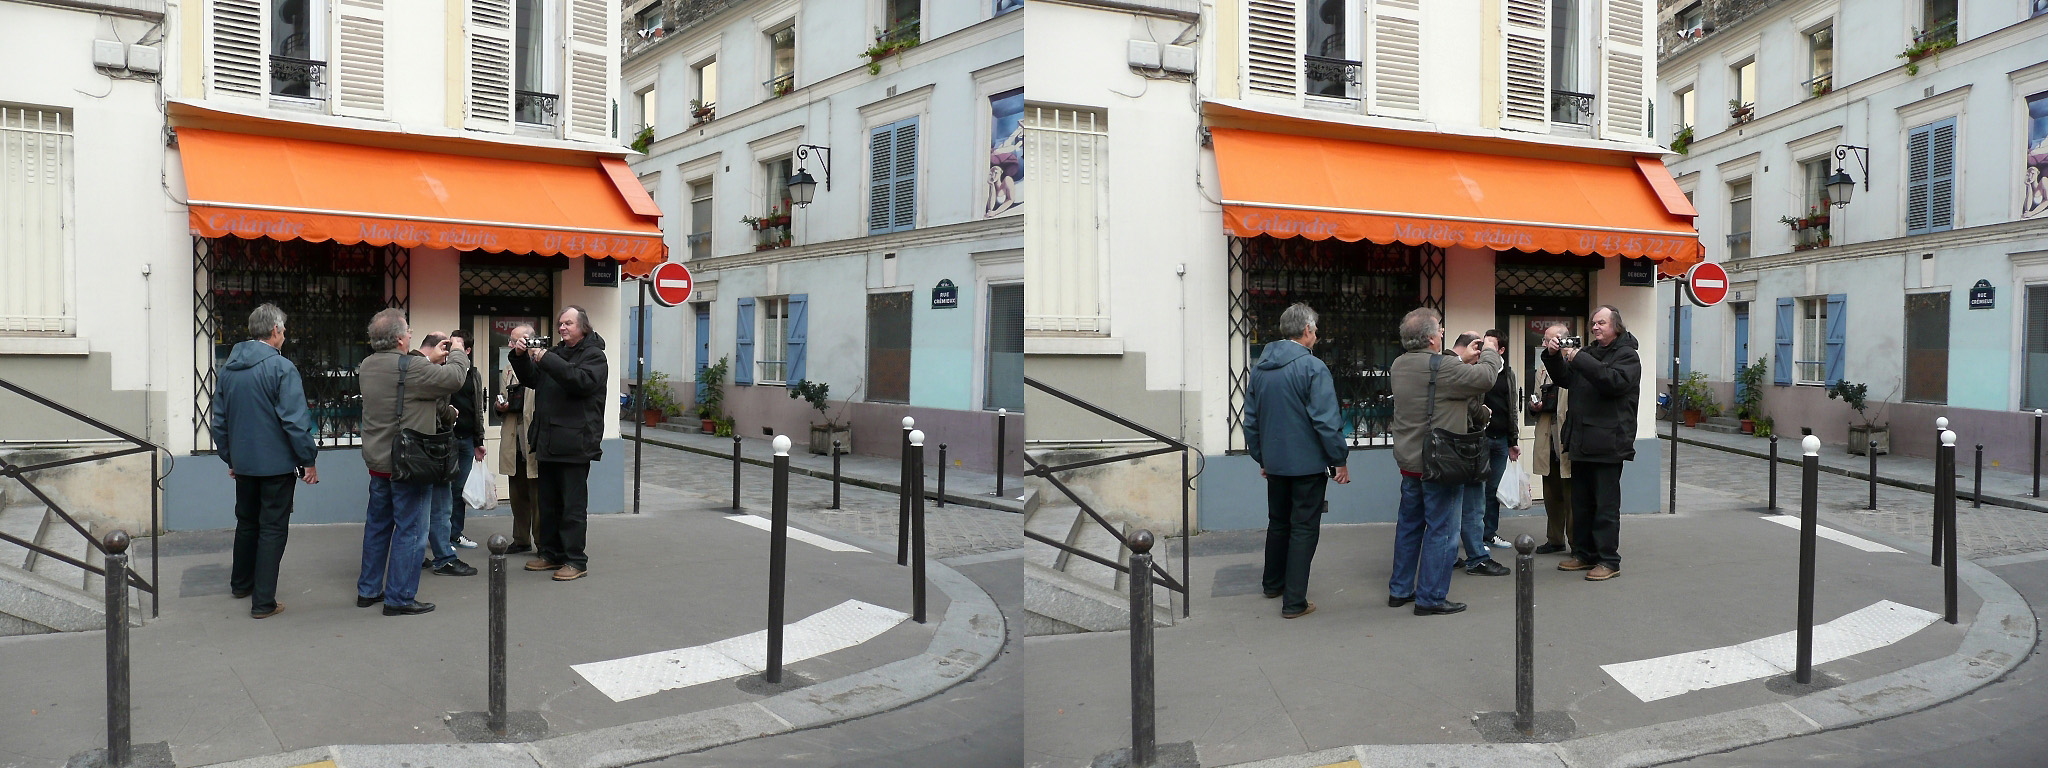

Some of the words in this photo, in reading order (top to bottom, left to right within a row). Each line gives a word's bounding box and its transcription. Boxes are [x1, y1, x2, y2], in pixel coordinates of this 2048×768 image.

[209, 213, 303, 235] Calandre
[358, 222, 430, 242] Modèles
[439, 227, 497, 246] réduits
[544, 234, 562, 250] 01
[566, 235, 586, 251] 43
[589, 237, 608, 253] 45
[610, 238, 629, 254] 72
[631, 239, 649, 255] 77
[1243, 213, 1338, 235] Calandre
[1393, 221, 1465, 241] Modèles
[1473, 227, 1532, 245] réduits
[1580, 233, 1597, 250] 01
[1601, 235, 1621, 251] 43
[1624, 237, 1643, 253] 45
[1645, 238, 1664, 254] 72
[1666, 239, 1684, 255] 77
